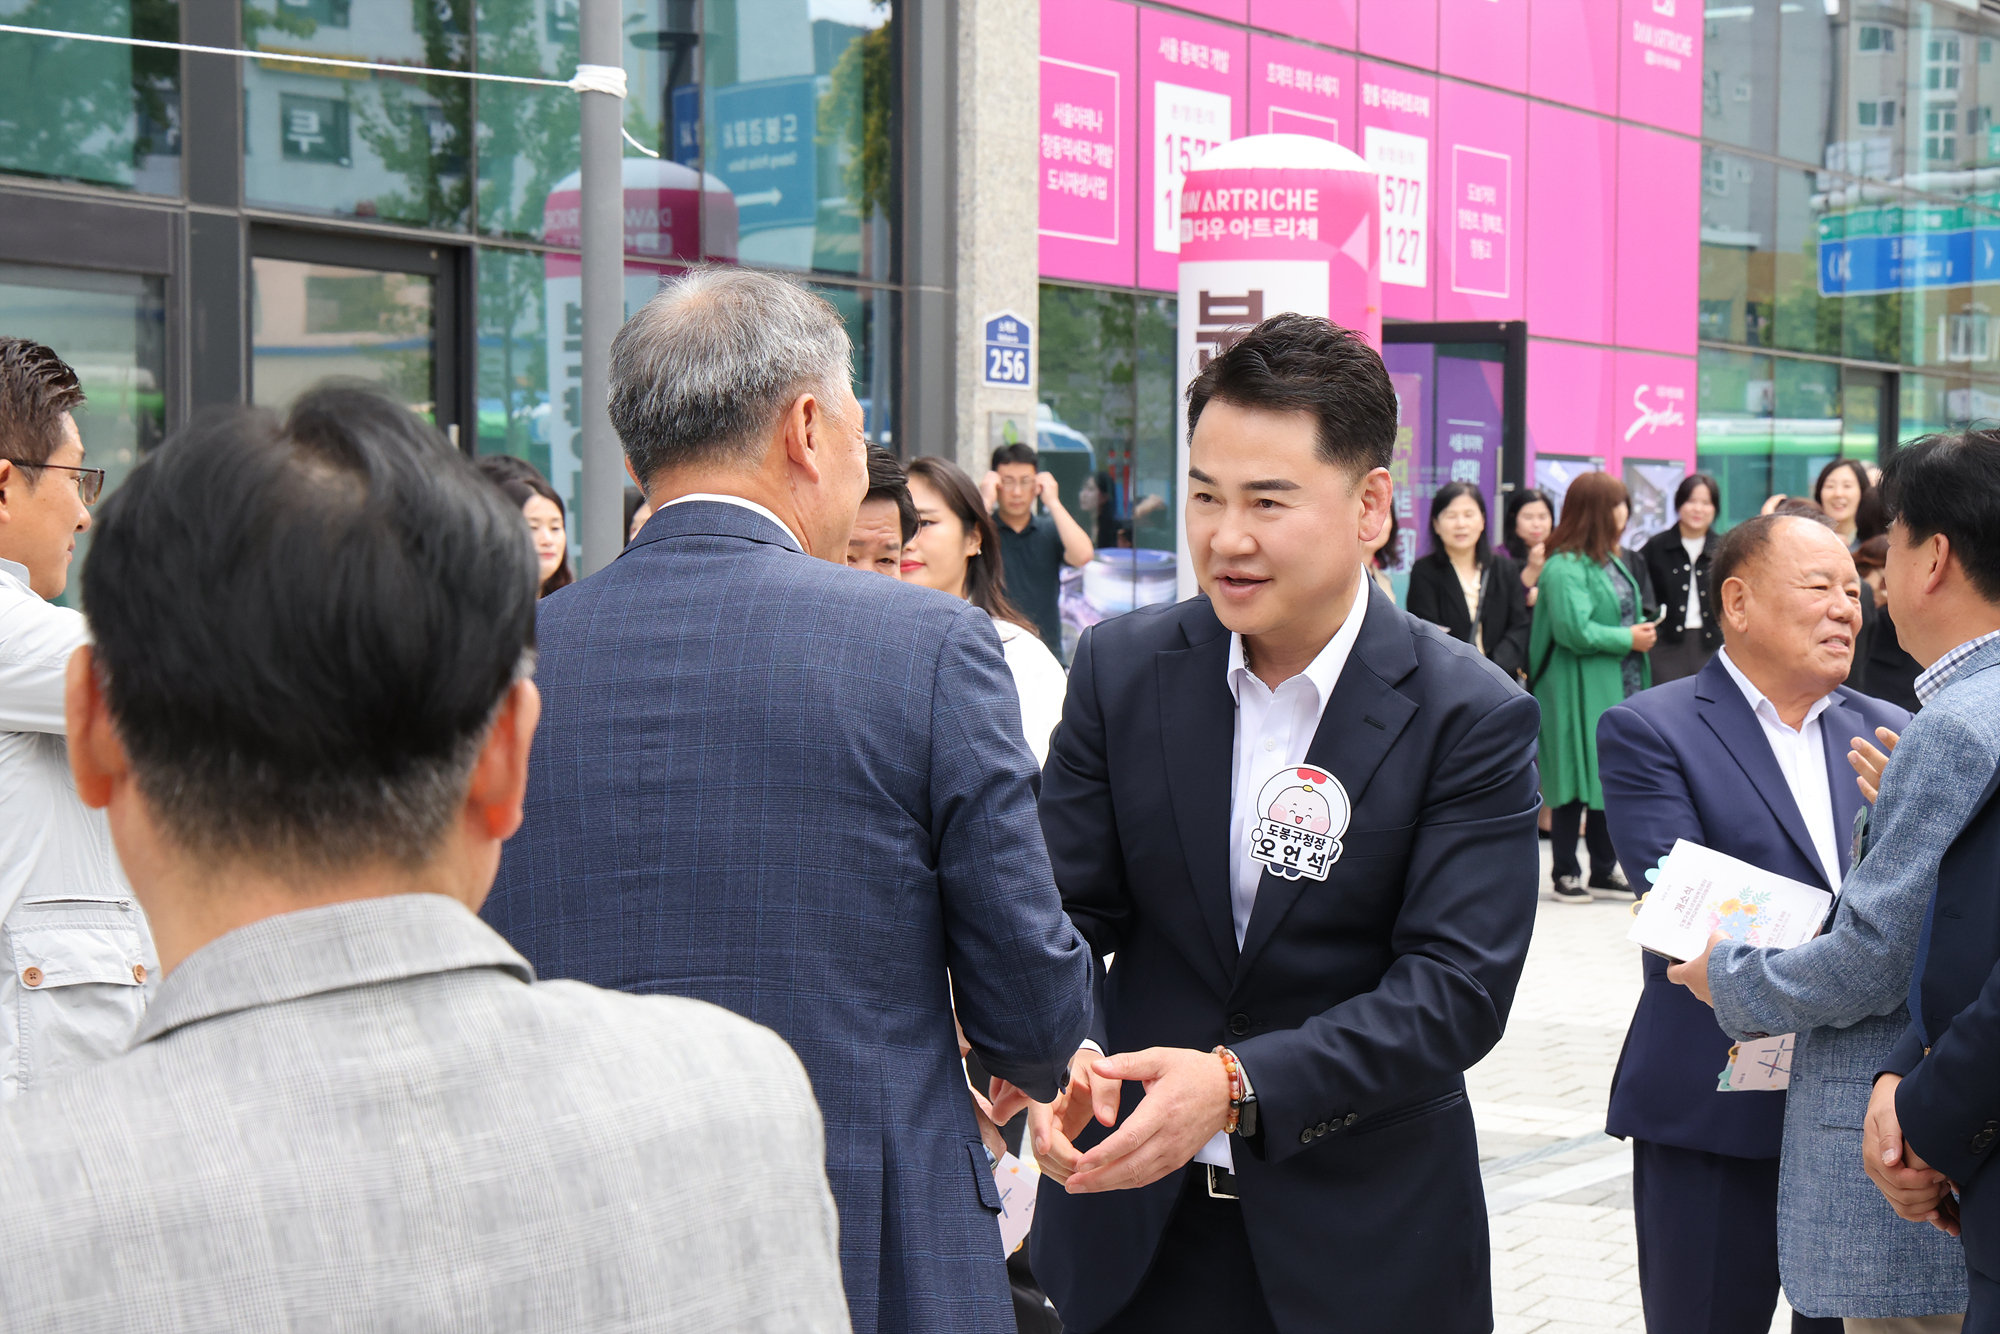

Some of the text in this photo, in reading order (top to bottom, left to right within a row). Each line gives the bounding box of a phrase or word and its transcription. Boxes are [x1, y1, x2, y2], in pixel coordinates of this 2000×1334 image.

[1158, 36, 1230, 75] 서울 동북권 개발
[1362, 82, 1381, 107] 창동
[1051, 102, 1104, 134] 서울아레나
[1165, 133, 1222, 177] 157
[1046, 168, 1107, 201] 도시재생사업
[1202, 187, 1319, 212] ARTRICHE
[1385, 174, 1420, 218] 577
[989, 347, 1026, 382] 256
[1266, 823, 1327, 851] 도봉구청장
[1674, 885, 1694, 913] 개소식
